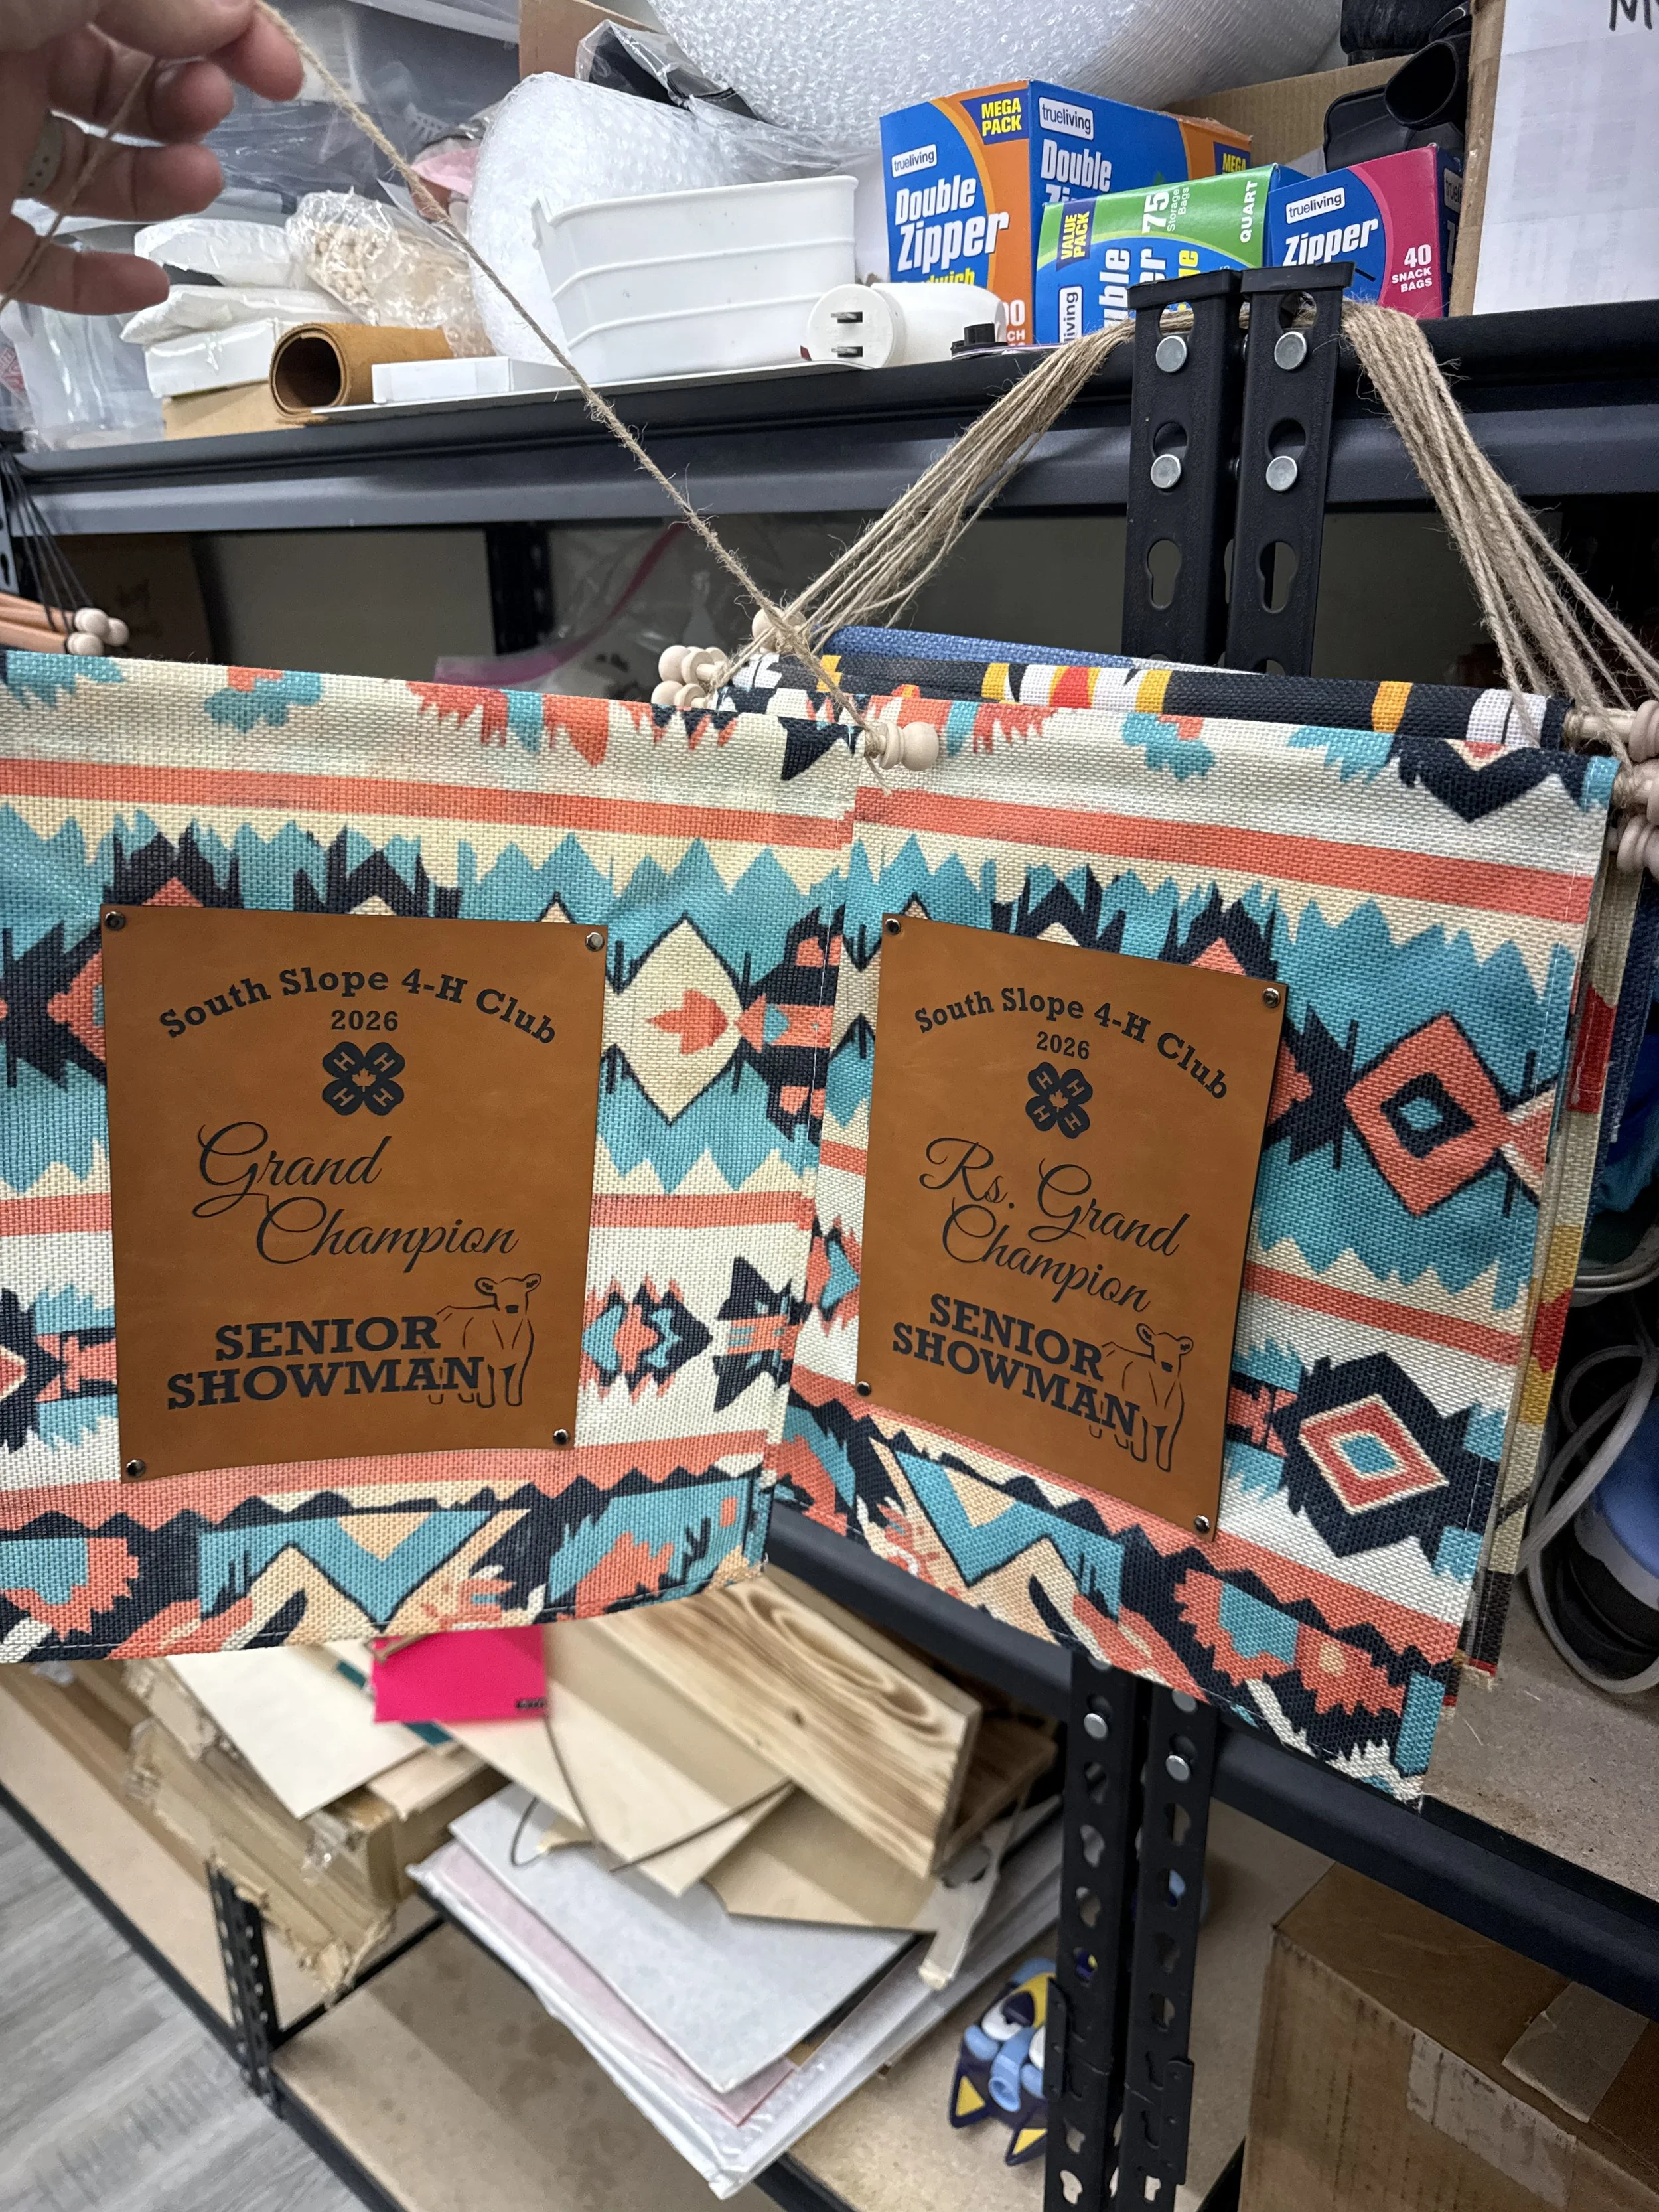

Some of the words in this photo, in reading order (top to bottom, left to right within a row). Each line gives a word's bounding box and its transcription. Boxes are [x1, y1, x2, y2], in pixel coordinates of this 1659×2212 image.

[981, 98, 1022, 119] MEGA
[982, 115, 1022, 137] PACK
[1042, 104, 1091, 135] trueliving
[894, 151, 934, 172] trueliving
[1041, 139, 1112, 192] Double
[1222, 153, 1246, 172] MEGA
[895, 175, 977, 225] Double
[1141, 191, 1170, 234] 75
[1167, 189, 1180, 232] Storage
[1178, 187, 1189, 216] Bags
[1240, 181, 1258, 244] QUART
[1289, 193, 1342, 218] trueliving
[897, 212, 1009, 275] Zipper
[1061, 214, 1077, 260] VALUE
[1073, 211, 1090, 258] PACK
[1283, 218, 1380, 266] Zipper
[1404, 244, 1432, 268] 40
[1099, 248, 1131, 329] uble
[1392, 267, 1432, 284] SNACK
[1400, 278, 1433, 293] BAGS
[1063, 291, 1079, 343] living
[159, 978, 272, 1038] South
[279, 967, 389, 997] Slope
[401, 969, 468, 1003] 4-H
[476, 989, 555, 1044] Club
[331, 1009, 398, 1031] 2026
[915, 990, 995, 1033] South
[1001, 987, 1084, 1021] Slope
[1094, 1003, 1151, 1044] 4-H
[1157, 1032, 1228, 1100] Club
[1036, 1031, 1090, 1060] 2026
[192, 1122, 392, 1218] Grand
[919, 1137, 1015, 1209] Rs.
[1028, 1158, 1190, 1256] Grand
[256, 1195, 519, 1273] Champion
[942, 1197, 1151, 1313] Champion
[215, 1316, 441, 1361] SENIOR
[930, 1293, 1103, 1382] SENIOR
[167, 1357, 484, 1410] SHOWMAN
[893, 1322, 1140, 1438] SHOWMAN
